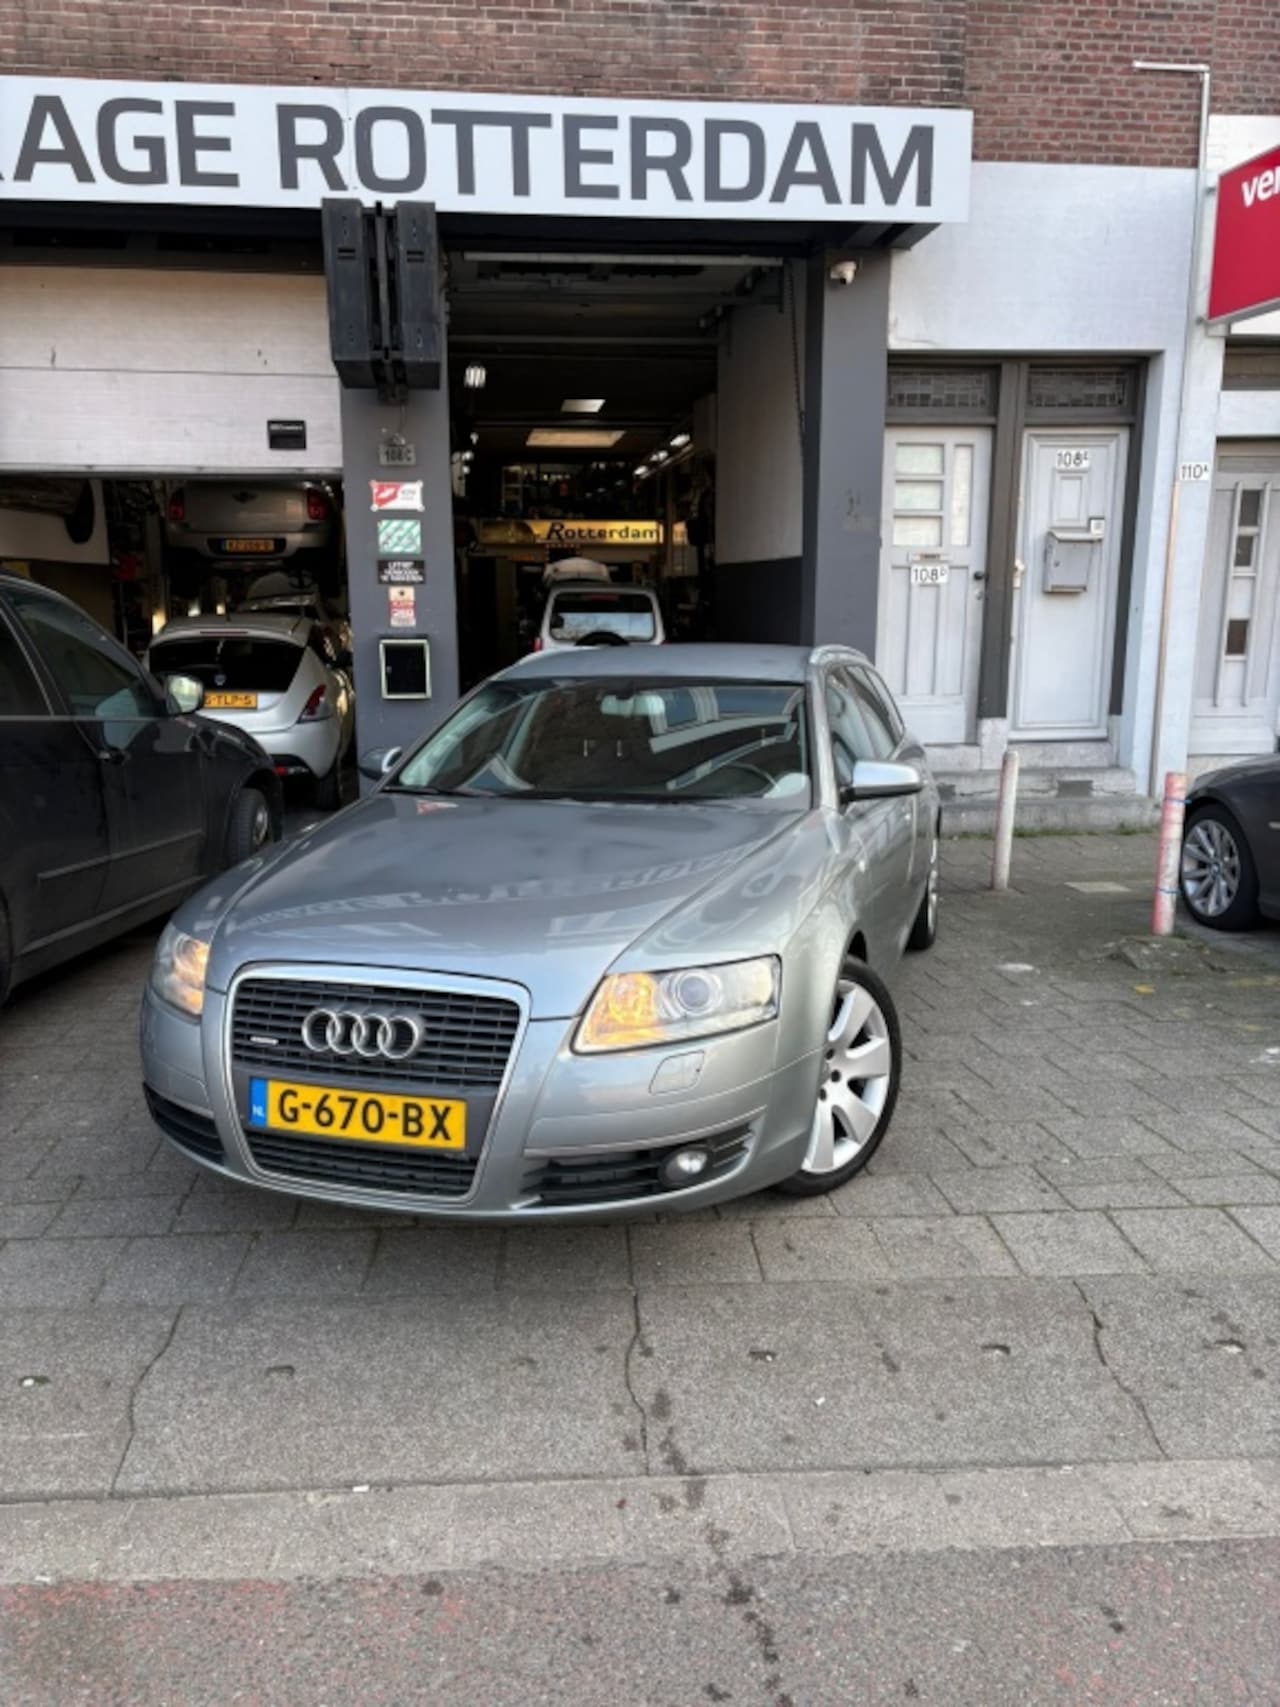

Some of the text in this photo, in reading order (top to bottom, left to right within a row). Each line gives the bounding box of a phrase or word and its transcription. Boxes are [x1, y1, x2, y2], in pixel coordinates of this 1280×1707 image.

[0, 94, 935, 207] AGE ROTTERDAM
[547, 521, 660, 541] Rotterdam
[278, 1089, 451, 1141] G-670-BX
